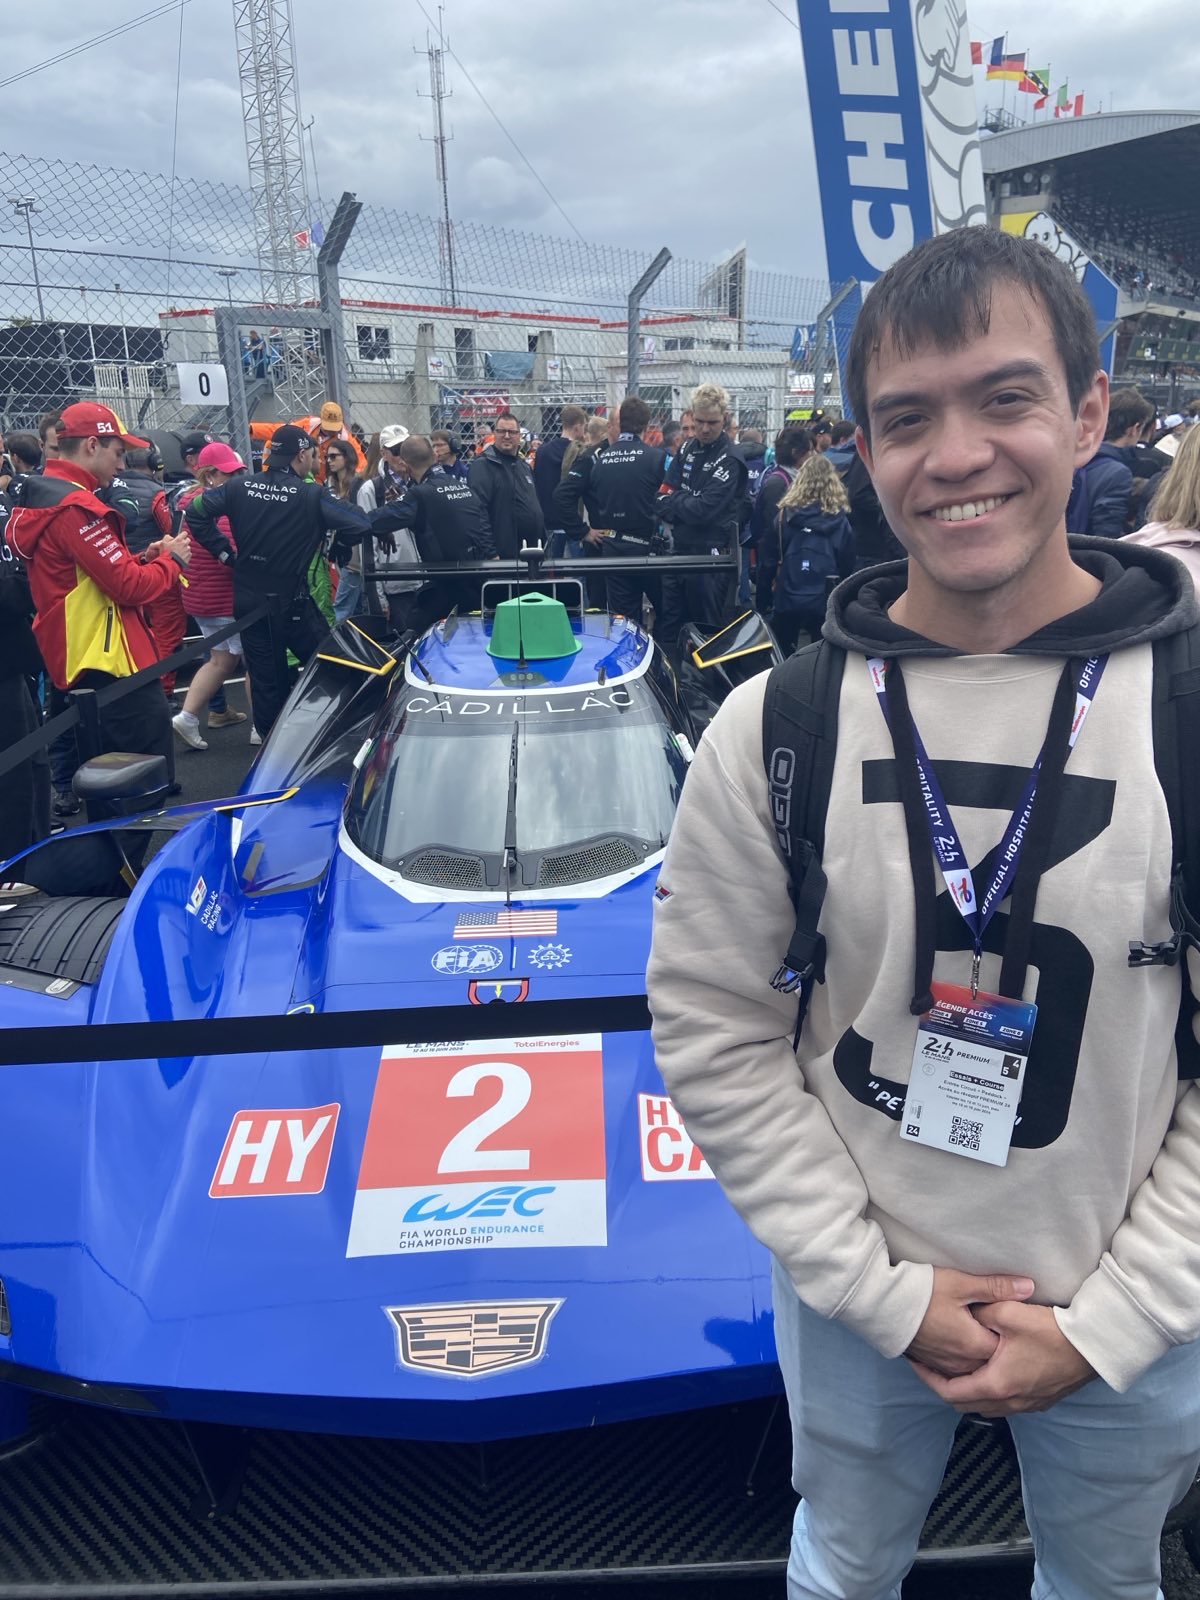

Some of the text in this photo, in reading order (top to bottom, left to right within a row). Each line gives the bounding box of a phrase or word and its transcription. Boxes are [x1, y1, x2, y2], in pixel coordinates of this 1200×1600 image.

[97, 422, 114, 433] 51
[602, 457, 636, 465] RACING
[1079, 654, 1100, 689] OFFIC
[406, 691, 634, 715] CADILLAC
[981, 864, 1009, 915] OFFICIAL
[200, 890, 219, 925] CADILLAC
[207, 904, 222, 932] RACING
[935, 1000, 967, 1014] ÉGENDE
[514, 1040, 580, 1049] TotalEnergies
[930, 1052, 951, 1061] MANS
[956, 1051, 990, 1064] PREMIUM
[1002, 1066, 1010, 1075] 5
[979, 1080, 1005, 1091] Course
[437, 1062, 532, 1174] 2
[646, 1099, 685, 1126] H
[907, 1125, 919, 1136] 24
[218, 1114, 332, 1185] HY
[402, 1186, 557, 1223] WEC
[400, 1224, 545, 1240] FIA WORLD ENDURANCE
[399, 1235, 493, 1249] CHAMPIONSHIP
